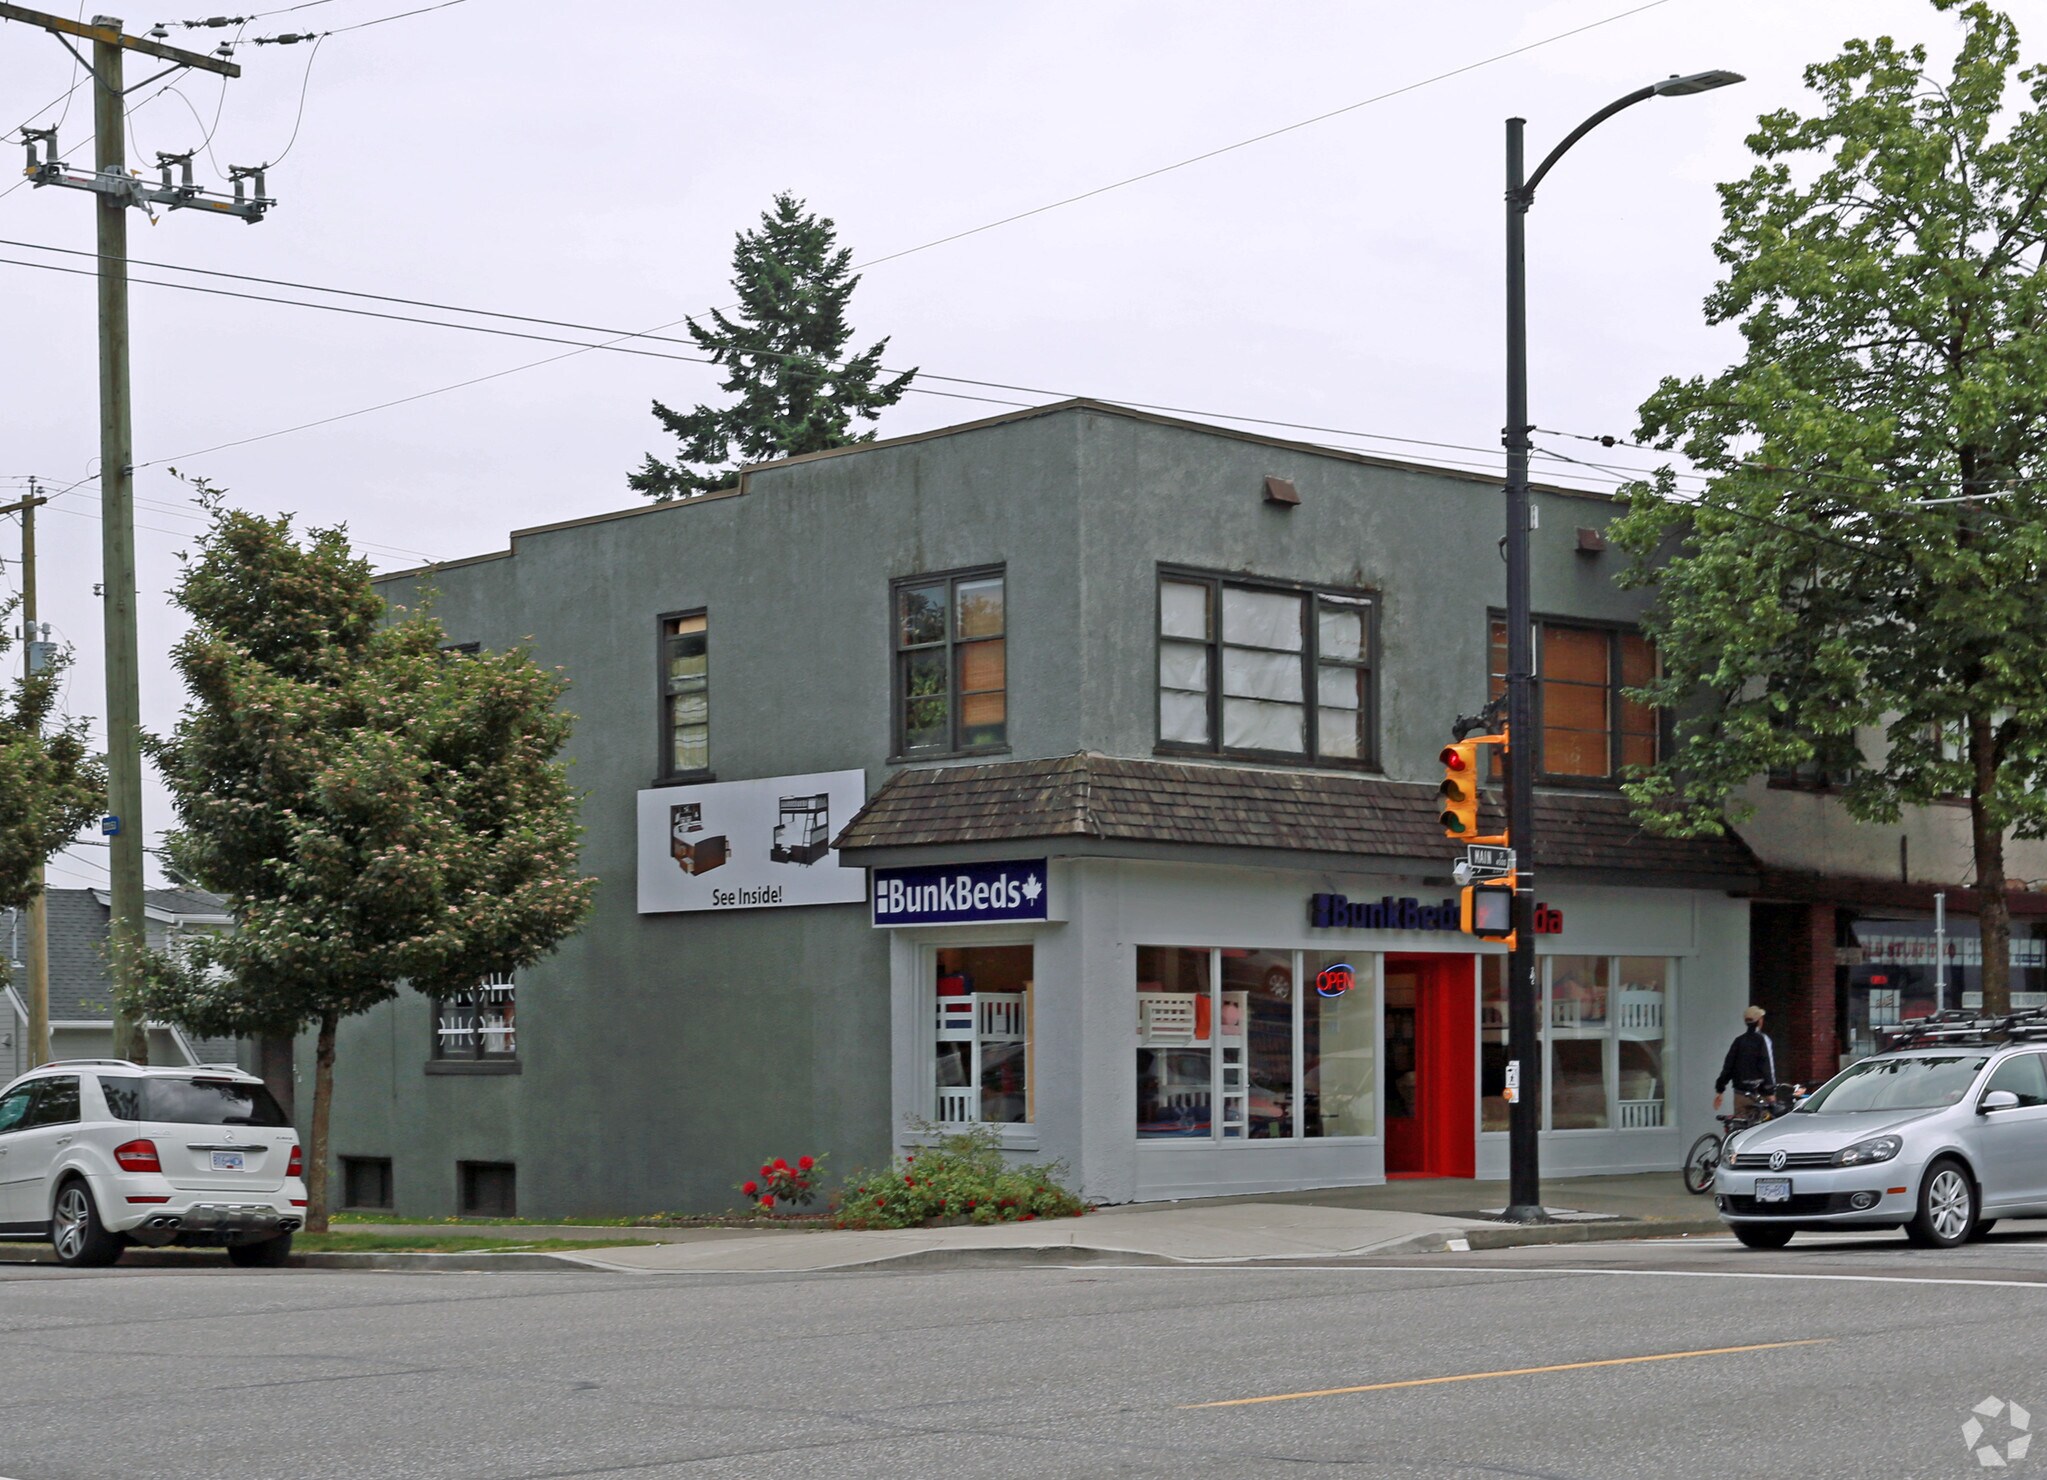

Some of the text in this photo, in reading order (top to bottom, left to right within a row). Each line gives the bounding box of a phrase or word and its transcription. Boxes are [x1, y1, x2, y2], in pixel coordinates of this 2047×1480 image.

[1474, 849, 1492, 865] MAIN
[712, 885, 782, 906] See Inside!
[889, 873, 1021, 914] BunkBeds
[1332, 893, 1461, 931] BunkBed
[1316, 971, 1355, 991] OPEN
